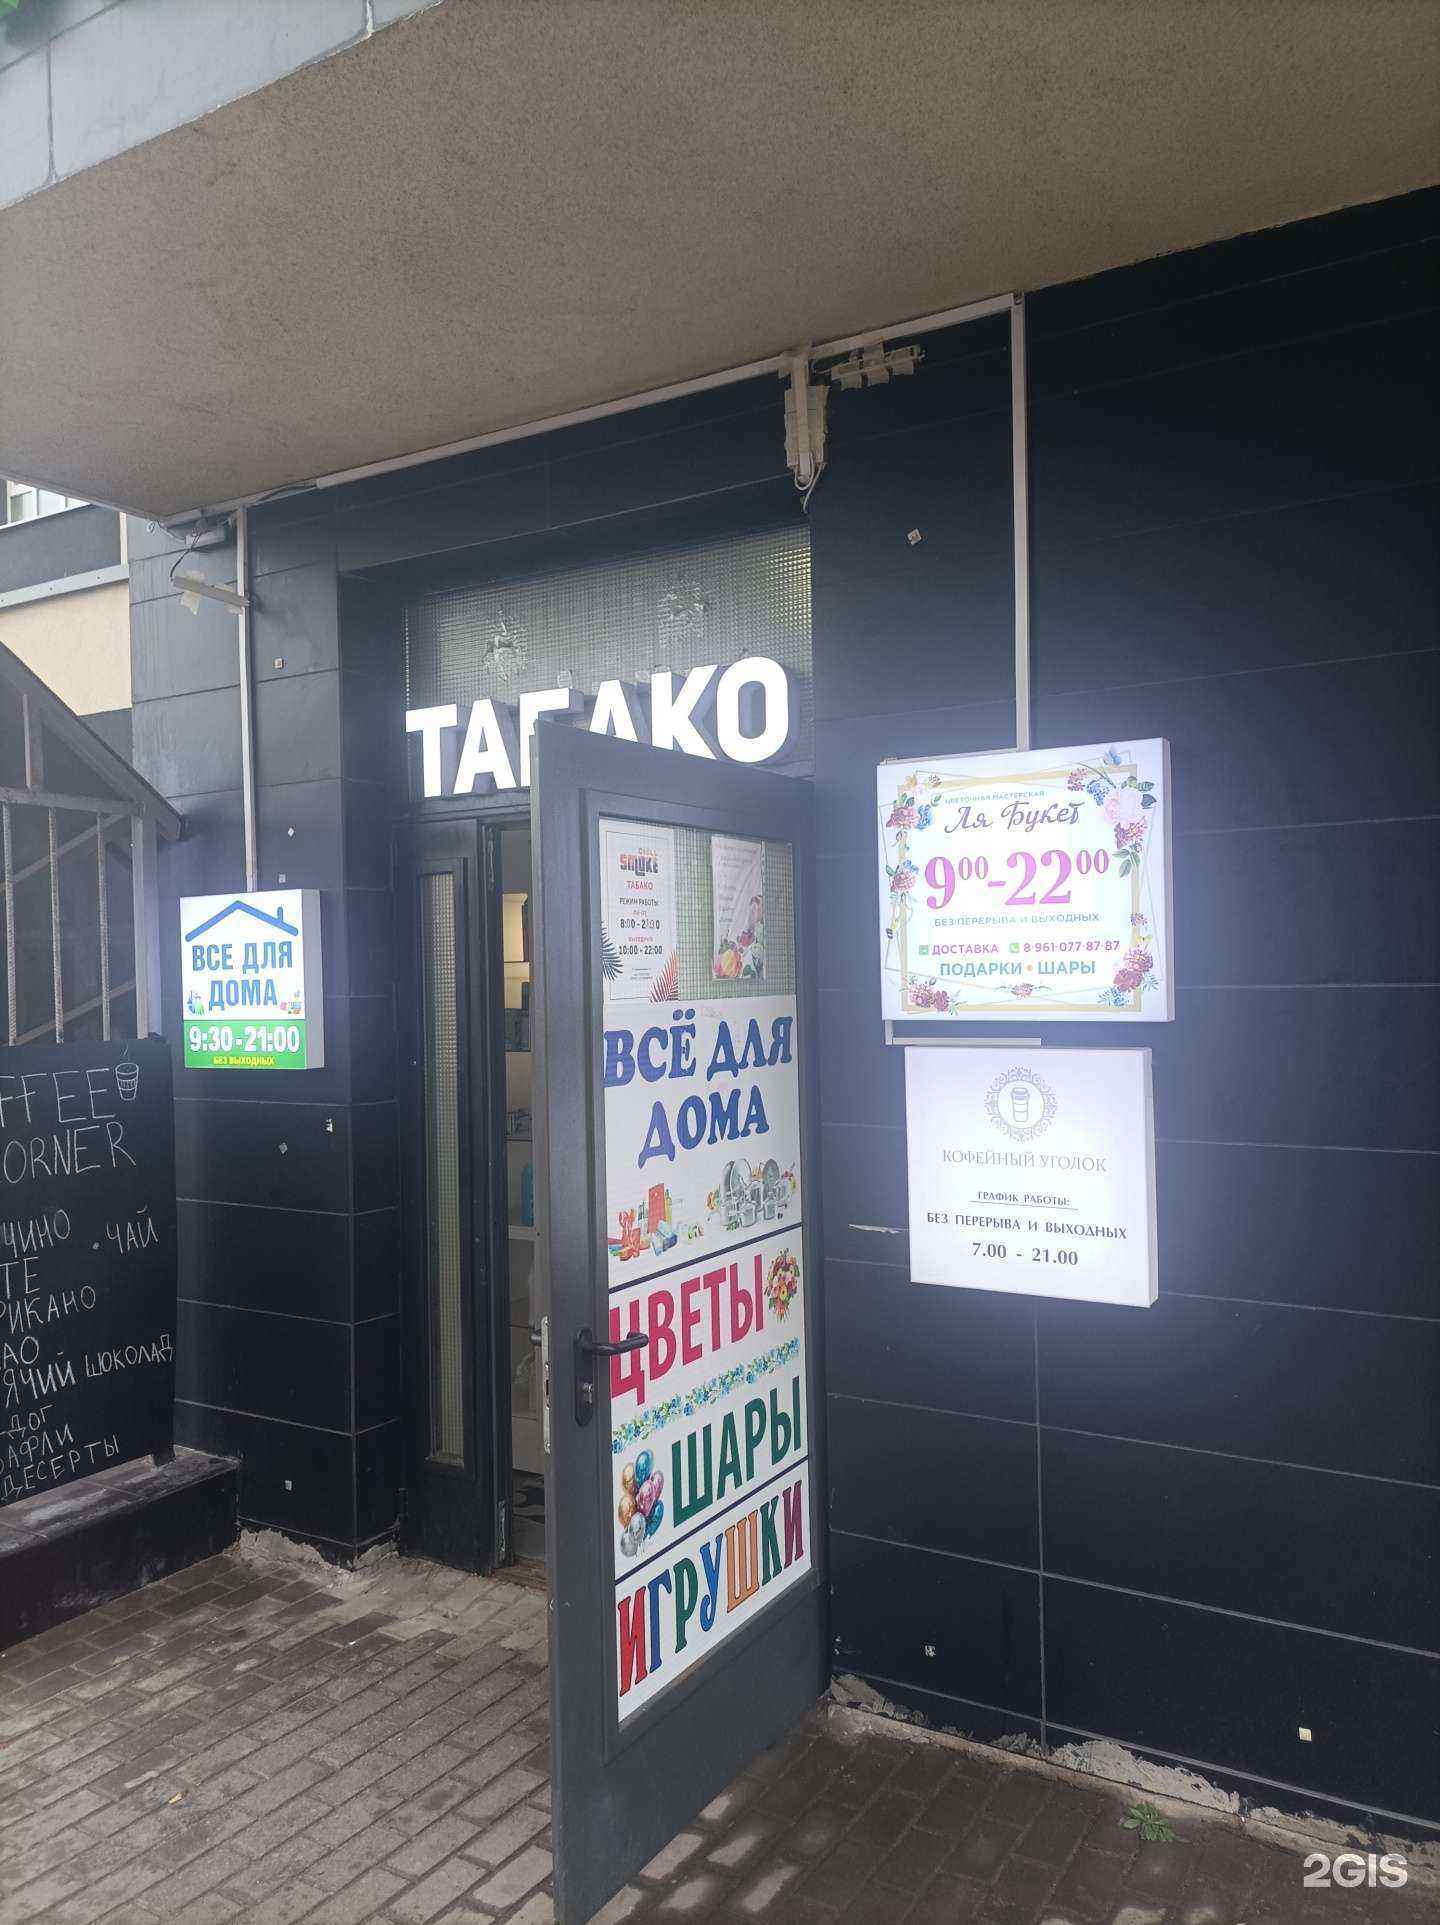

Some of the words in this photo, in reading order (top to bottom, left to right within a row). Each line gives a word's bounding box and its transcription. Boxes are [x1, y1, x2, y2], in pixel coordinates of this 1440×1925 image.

[944, 806, 993, 833] Ля
[1000, 801, 1085, 832] Букет
[626, 880, 654, 890] ТАБАКО
[934, 917, 955, 927] БЕЗ
[957, 916, 1017, 926] ПЕРЕРЫВА
[1030, 913, 1100, 924] ВЫХОДНЫХ
[192, 943, 234, 972] ВСЕ
[242, 941, 293, 974] ДЛЯ
[619, 945, 638, 955] 10:00
[931, 943, 999, 956] ДОСТАВКА
[940, 961, 1022, 977] ПОДАРКИ
[1038, 961, 1096, 975] ШАРЫ
[208, 978, 278, 1011] ДОМА
[213, 1055, 229, 1065] БЕЗ
[229, 1055, 275, 1067] ВЫХОДНЫХ
[603, 1008, 697, 1088] ВСЁ
[706, 1016, 793, 1082] ДЛЯ
[638, 1085, 770, 1169] ДОМА
[3, 1121, 136, 1184] ORNER
[942, 1149, 1035, 1168] КОФЕЙНЫЙ
[1039, 1156, 1107, 1172] УГОЛОК
[977, 1191, 1019, 1202] ГРАФИК
[1024, 1194, 1070, 1206] РАБОТЫ:
[3, 1209, 71, 1257] ЧИНО
[106, 1205, 158, 1254] ЧАЙ
[927, 1212, 949, 1224] БЕЗ
[955, 1214, 1021, 1230] ПЕРЕРЫВА
[1028, 1220, 1038, 1232] И
[1045, 1221, 1127, 1240] ВЫХОДНЫХ
[972, 1242, 1007, 1259] 7.00
[1032, 1248, 1078, 1265] 21.00
[0, 1256, 40, 1299] ТЕ
[609, 1254, 764, 1406] ЦВЕТЫ
[3, 1351, 77, 1408] ЯЧИЙ
[85, 1334, 173, 1377] ШОКОЛАД
[3, 1434, 120, 1498] ДЕСЕРТЫ
[671, 1375, 801, 1528] ШАРЫ
[617, 1480, 804, 1697] ИГРУШКИ
